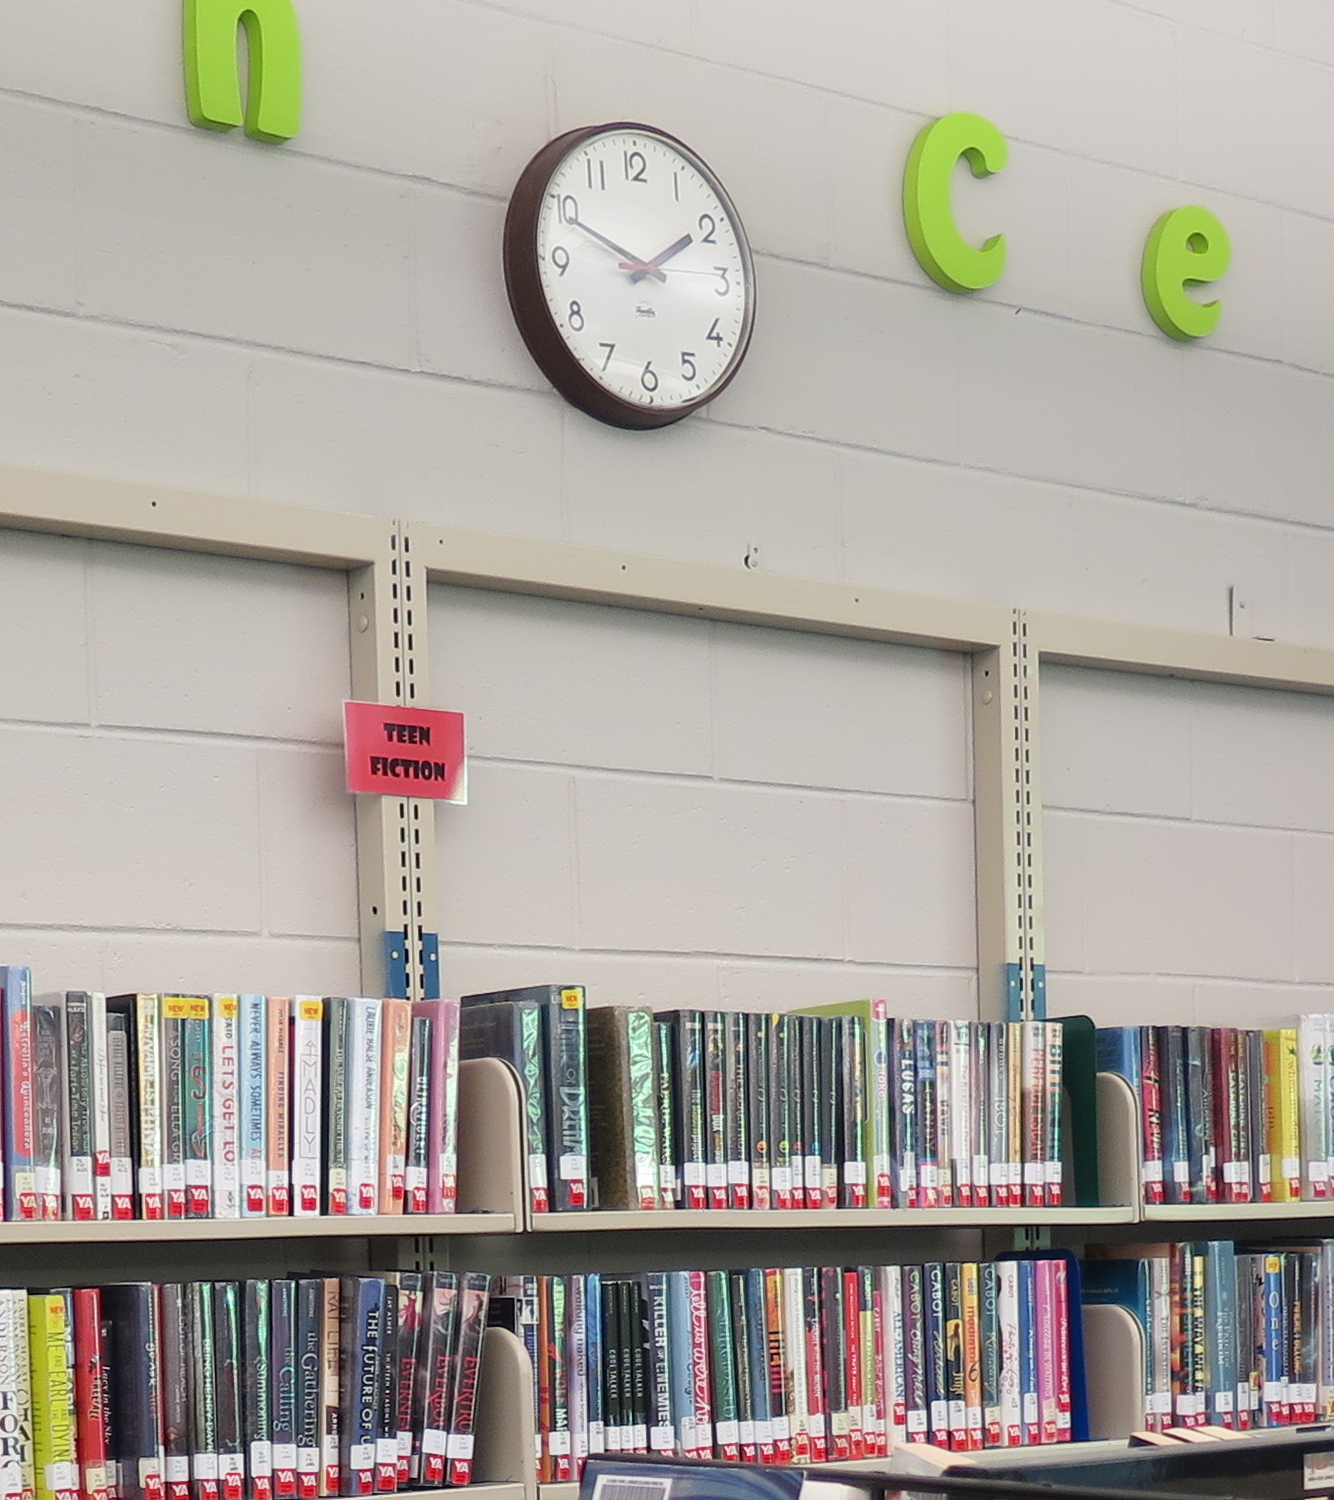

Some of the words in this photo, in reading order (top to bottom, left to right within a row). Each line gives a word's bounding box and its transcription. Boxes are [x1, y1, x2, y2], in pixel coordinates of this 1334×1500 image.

[586, 159, 606, 190] 11
[623, 151, 647, 183] 12
[557, 194, 579, 224] 10
[698, 214, 716, 244] 2
[552, 246, 570, 277] 9
[714, 267, 729, 296] 3
[569, 301, 585, 331] 8
[706, 319, 724, 347] 4
[599, 342, 615, 371] 7
[680, 352, 697, 381] 5
[640, 361, 658, 392] 6
[383, 723, 430, 746] TEEN
[370, 756, 446, 781] FICTION
[301, 1186, 317, 1199] YA
